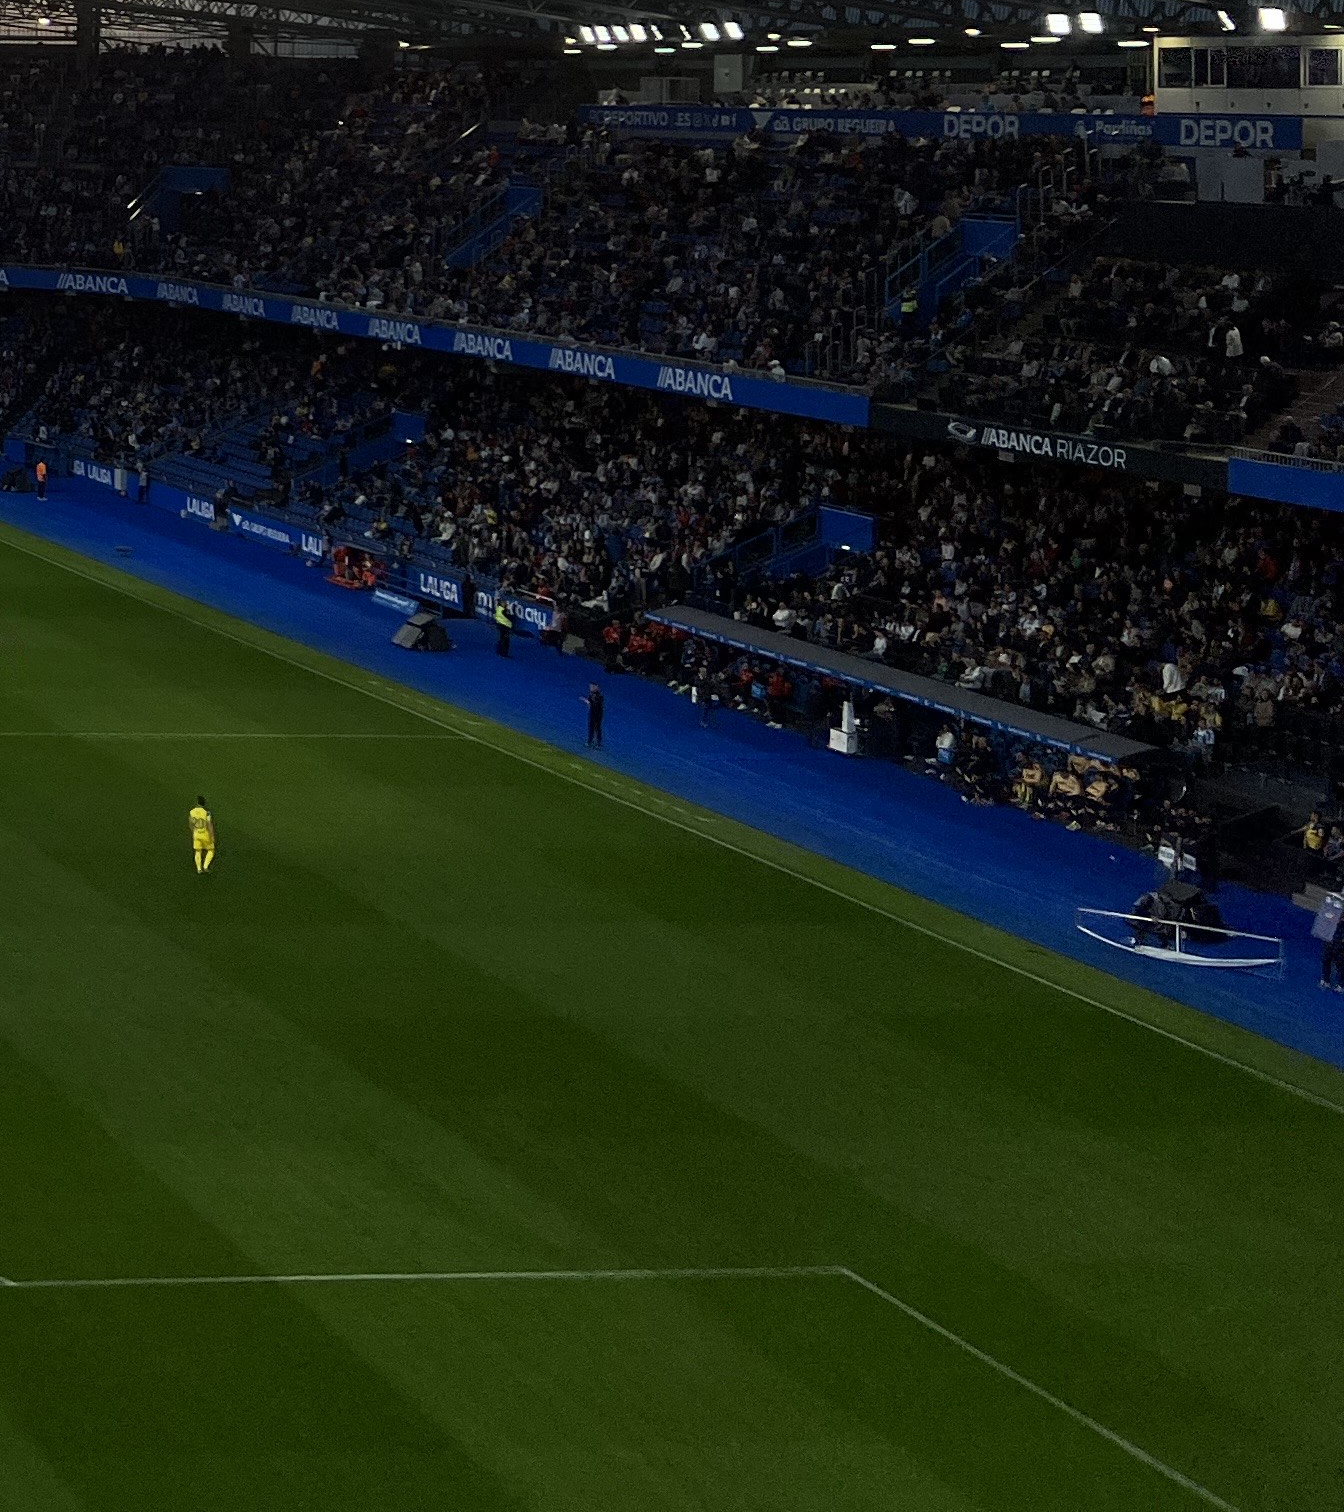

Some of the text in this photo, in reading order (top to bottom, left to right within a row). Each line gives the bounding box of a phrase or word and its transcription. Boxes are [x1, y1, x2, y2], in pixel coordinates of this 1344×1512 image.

[943, 115, 1019, 138] DEPOR
[1179, 118, 1275, 148] DEPOR
[1056, 438, 1128, 471] RIAZOR
[301, 533, 323, 557] LALI
